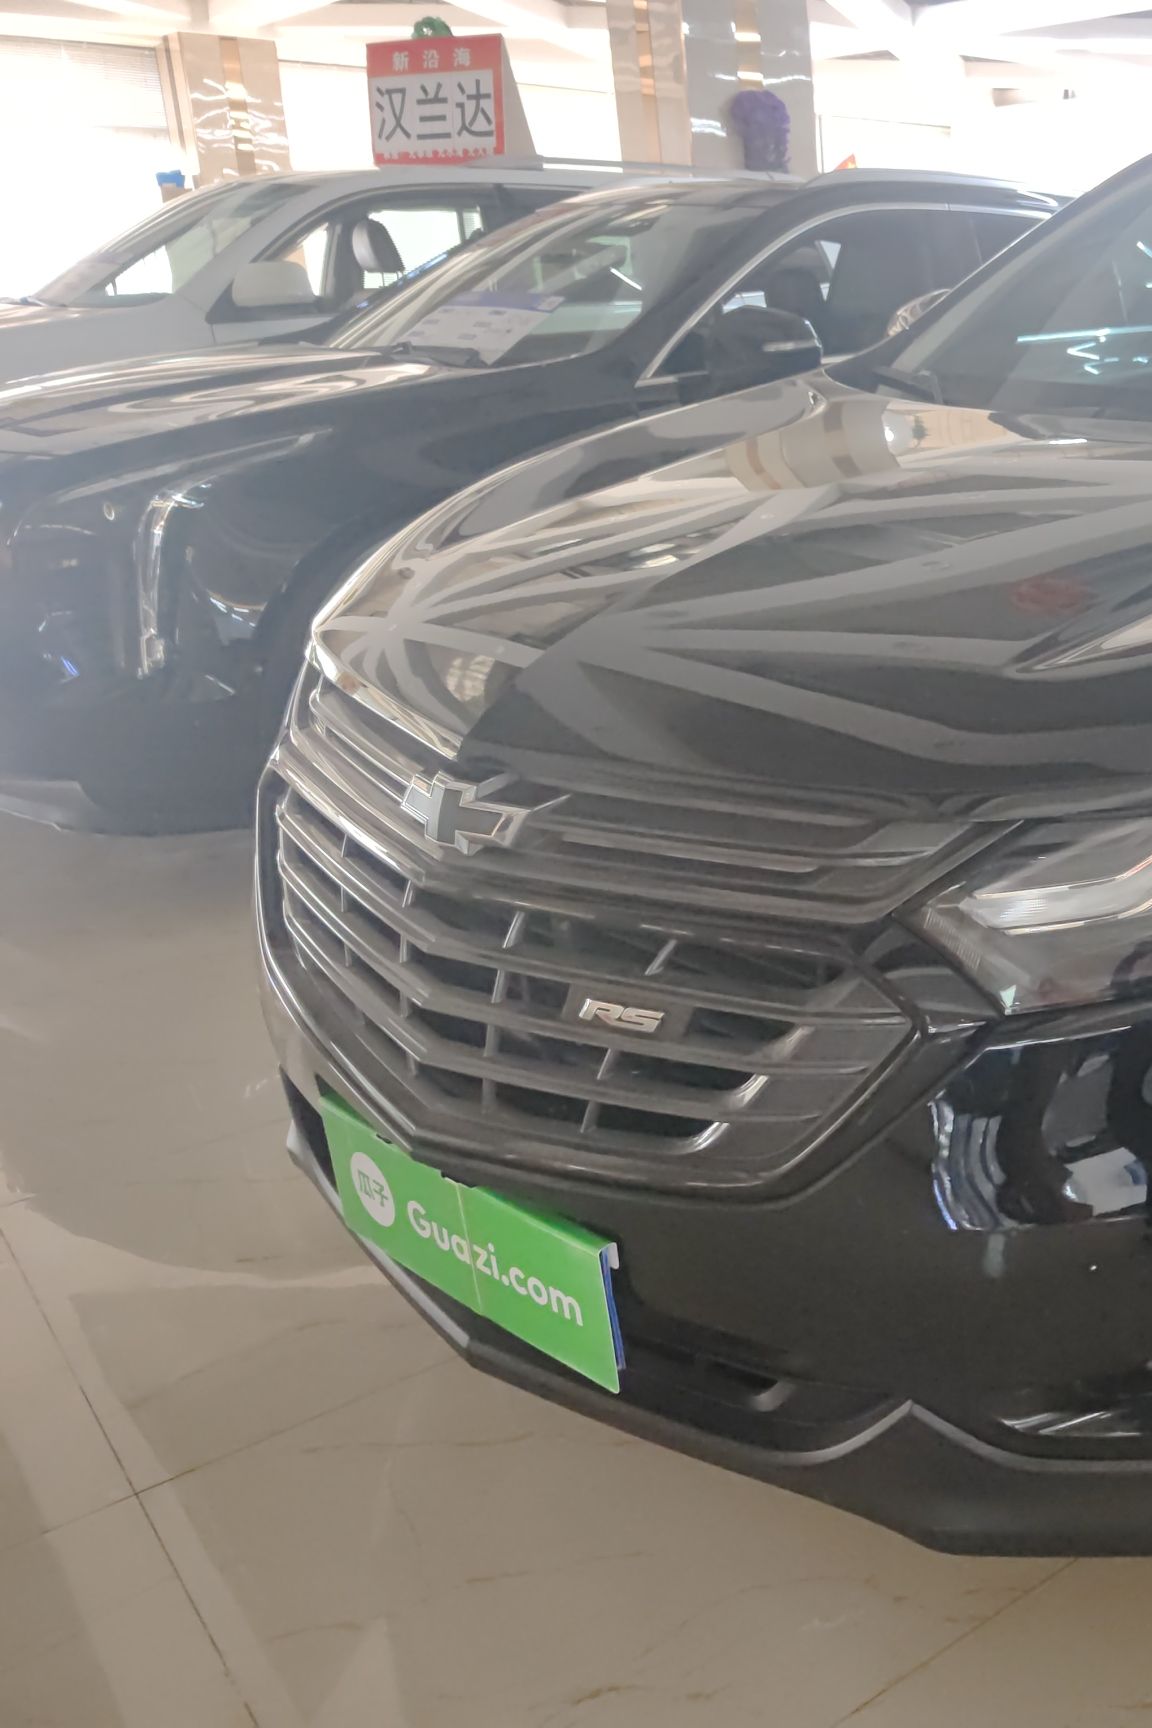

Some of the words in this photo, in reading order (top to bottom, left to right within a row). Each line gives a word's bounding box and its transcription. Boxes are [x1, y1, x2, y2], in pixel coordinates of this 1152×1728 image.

[392, 48, 471, 72] 新沿海
[375, 78, 494, 142] 汉兰达
[579, 998, 664, 1032] RS
[406, 1200, 584, 1327] Guazi.com
